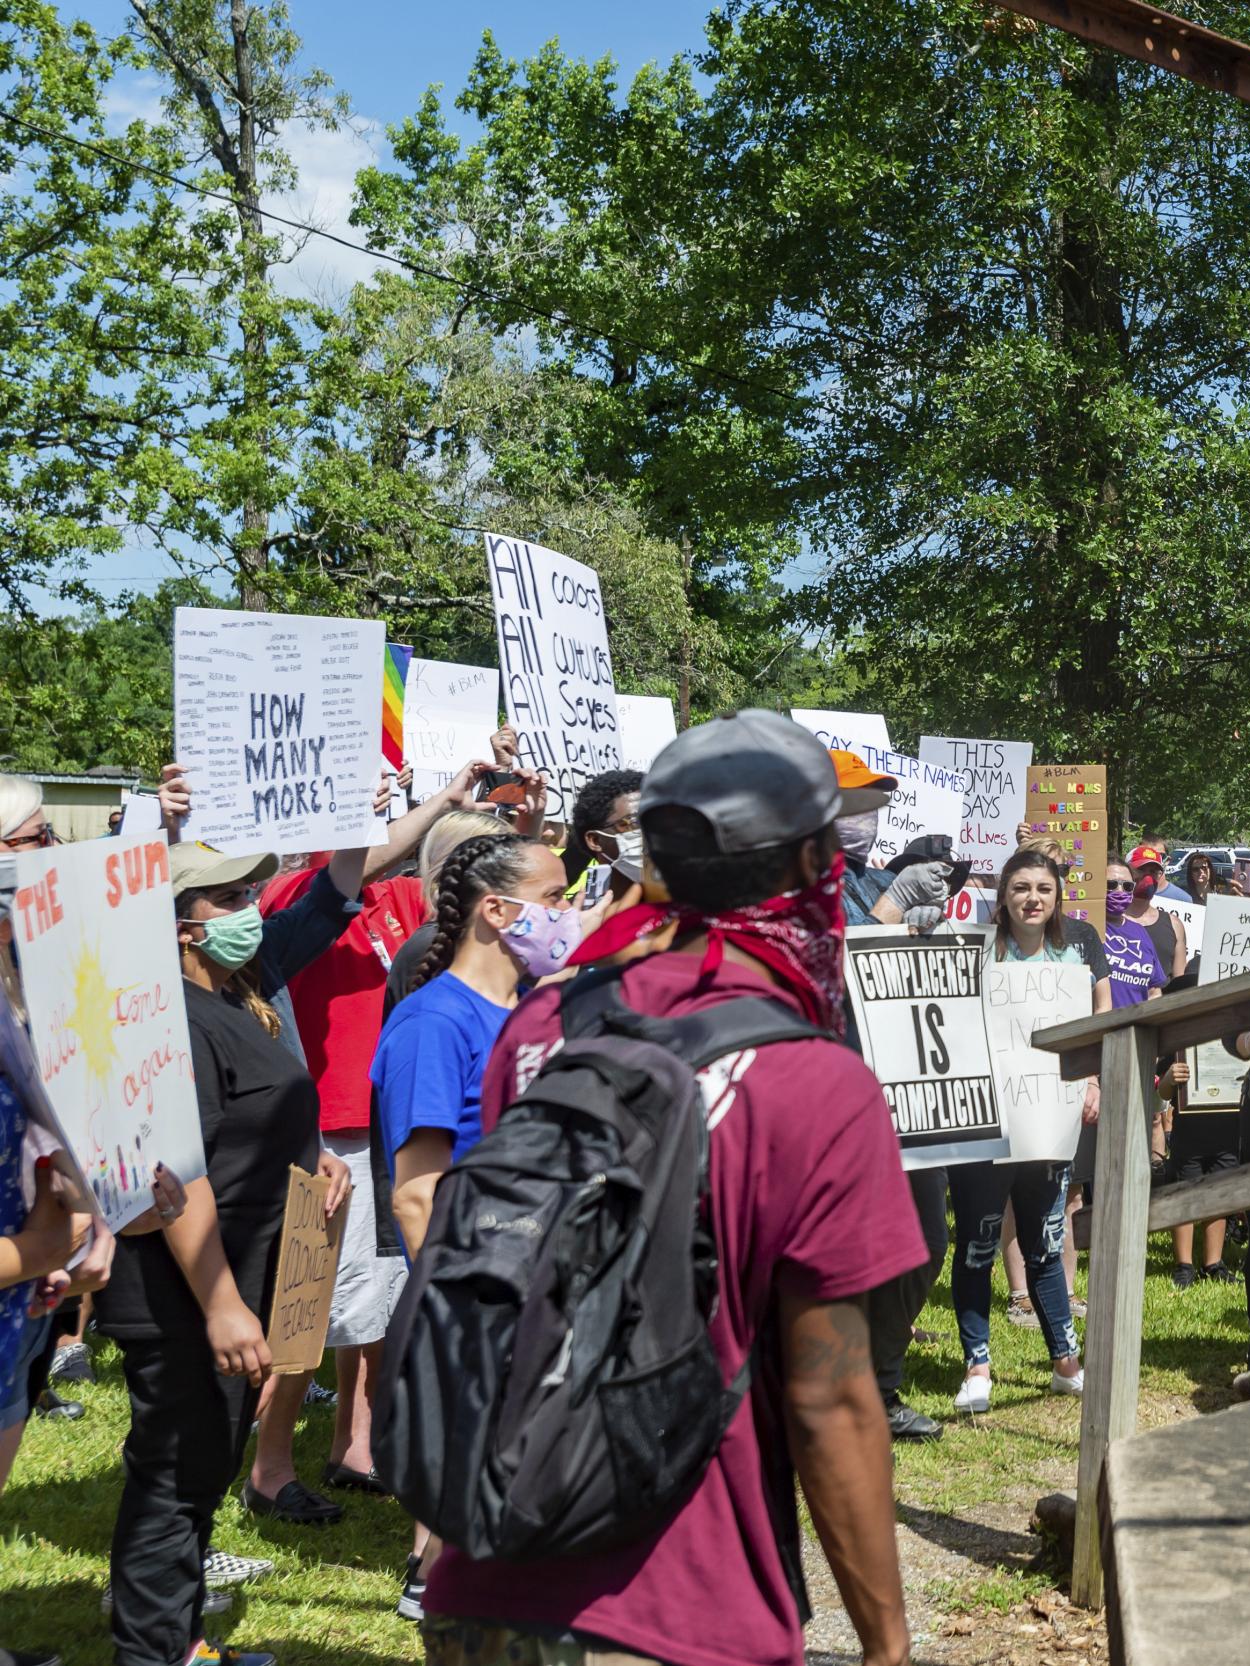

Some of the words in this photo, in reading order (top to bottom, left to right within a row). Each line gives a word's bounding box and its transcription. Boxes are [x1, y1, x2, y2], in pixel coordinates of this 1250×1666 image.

[488, 535, 543, 620] All
[552, 571, 601, 617] colors
[500, 613, 544, 676] All
[448, 672, 487, 697] #BLM
[509, 674, 551, 728] All
[250, 692, 305, 740] HOW
[244, 735, 326, 785] MANY
[407, 728, 456, 761] TER!
[517, 730, 557, 768] All
[562, 730, 621, 771] beliefs
[947, 741, 1005, 769] THIS
[862, 745, 919, 780] THEIR
[923, 765, 966, 793] NAMES
[1044, 767, 1081, 777] #BLM
[252, 775, 337, 825] MORE?
[889, 790, 917, 807] oyd
[1030, 783, 1056, 793] ALL
[1067, 783, 1101, 795] MOMS
[886, 804, 926, 833] Taylor
[1049, 802, 1084, 814] WERE
[977, 823, 1008, 846] Lives
[1030, 820, 1099, 833] ACTIVATED
[874, 838, 898, 856] ves
[1062, 889, 1086, 900] LED
[1066, 871, 1092, 884] OYD
[15, 867, 65, 943] THE
[856, 948, 978, 1001] COMPLACENCY
[990, 968, 1073, 1008] BLACK
[1108, 970, 1150, 986] aumont
[911, 1003, 950, 1075] IS
[123, 1028, 196, 1116] again
[883, 1077, 998, 1134] COMPLICITY
